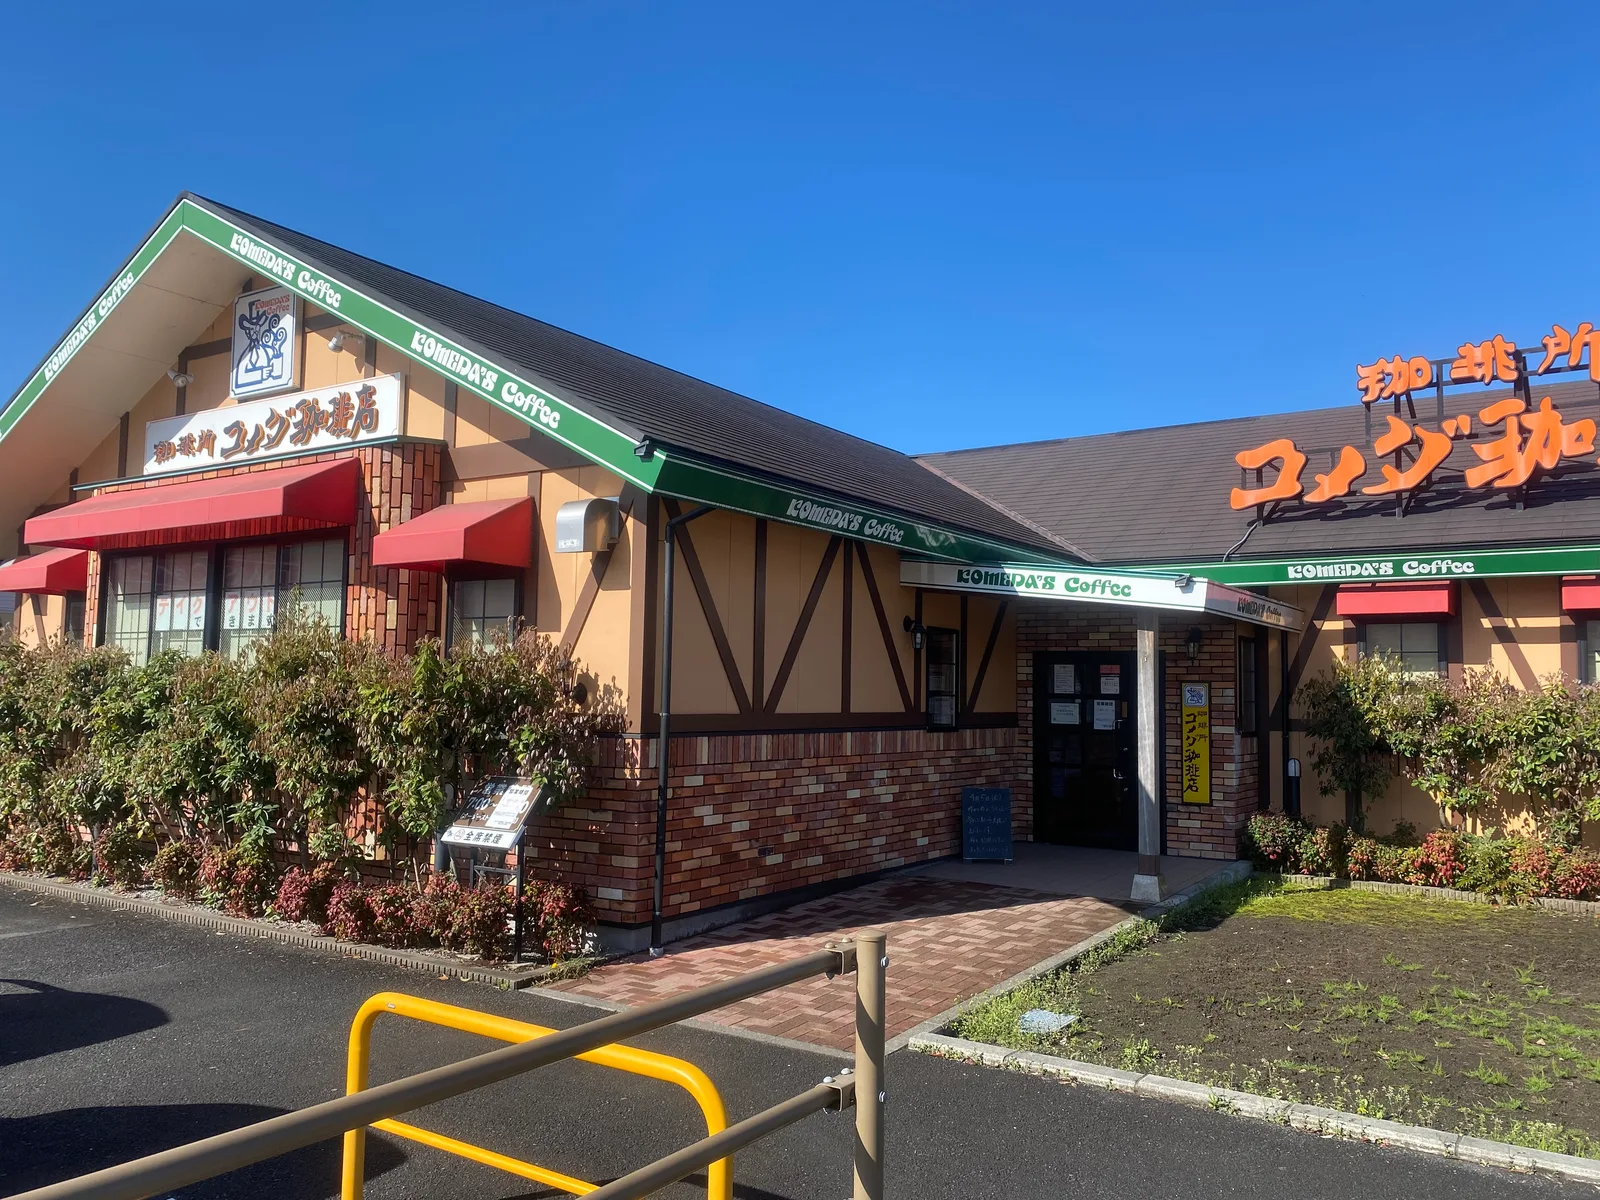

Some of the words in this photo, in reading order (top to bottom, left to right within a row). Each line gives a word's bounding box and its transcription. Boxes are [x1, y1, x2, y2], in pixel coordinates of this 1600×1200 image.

[230, 233, 296, 280] KOMEDA'S
[298, 270, 341, 308] Coffee
[44, 313, 96, 381] KOMEDA'S
[99, 272, 134, 317] Coffee
[266, 303, 290, 316] Coffee
[410, 331, 498, 392] KOMEDA'S
[501, 381, 561, 429] Coffee
[1230, 396, 1600, 510] コメダ珈
[786, 498, 863, 531] KOMEDA'S
[863, 518, 904, 543] Coffee
[957, 568, 1056, 591] KOMEDA'S
[1064, 576, 1132, 598] Coffee
[1287, 561, 1393, 579] KOMEDA'S
[1402, 559, 1475, 575] Coffee
